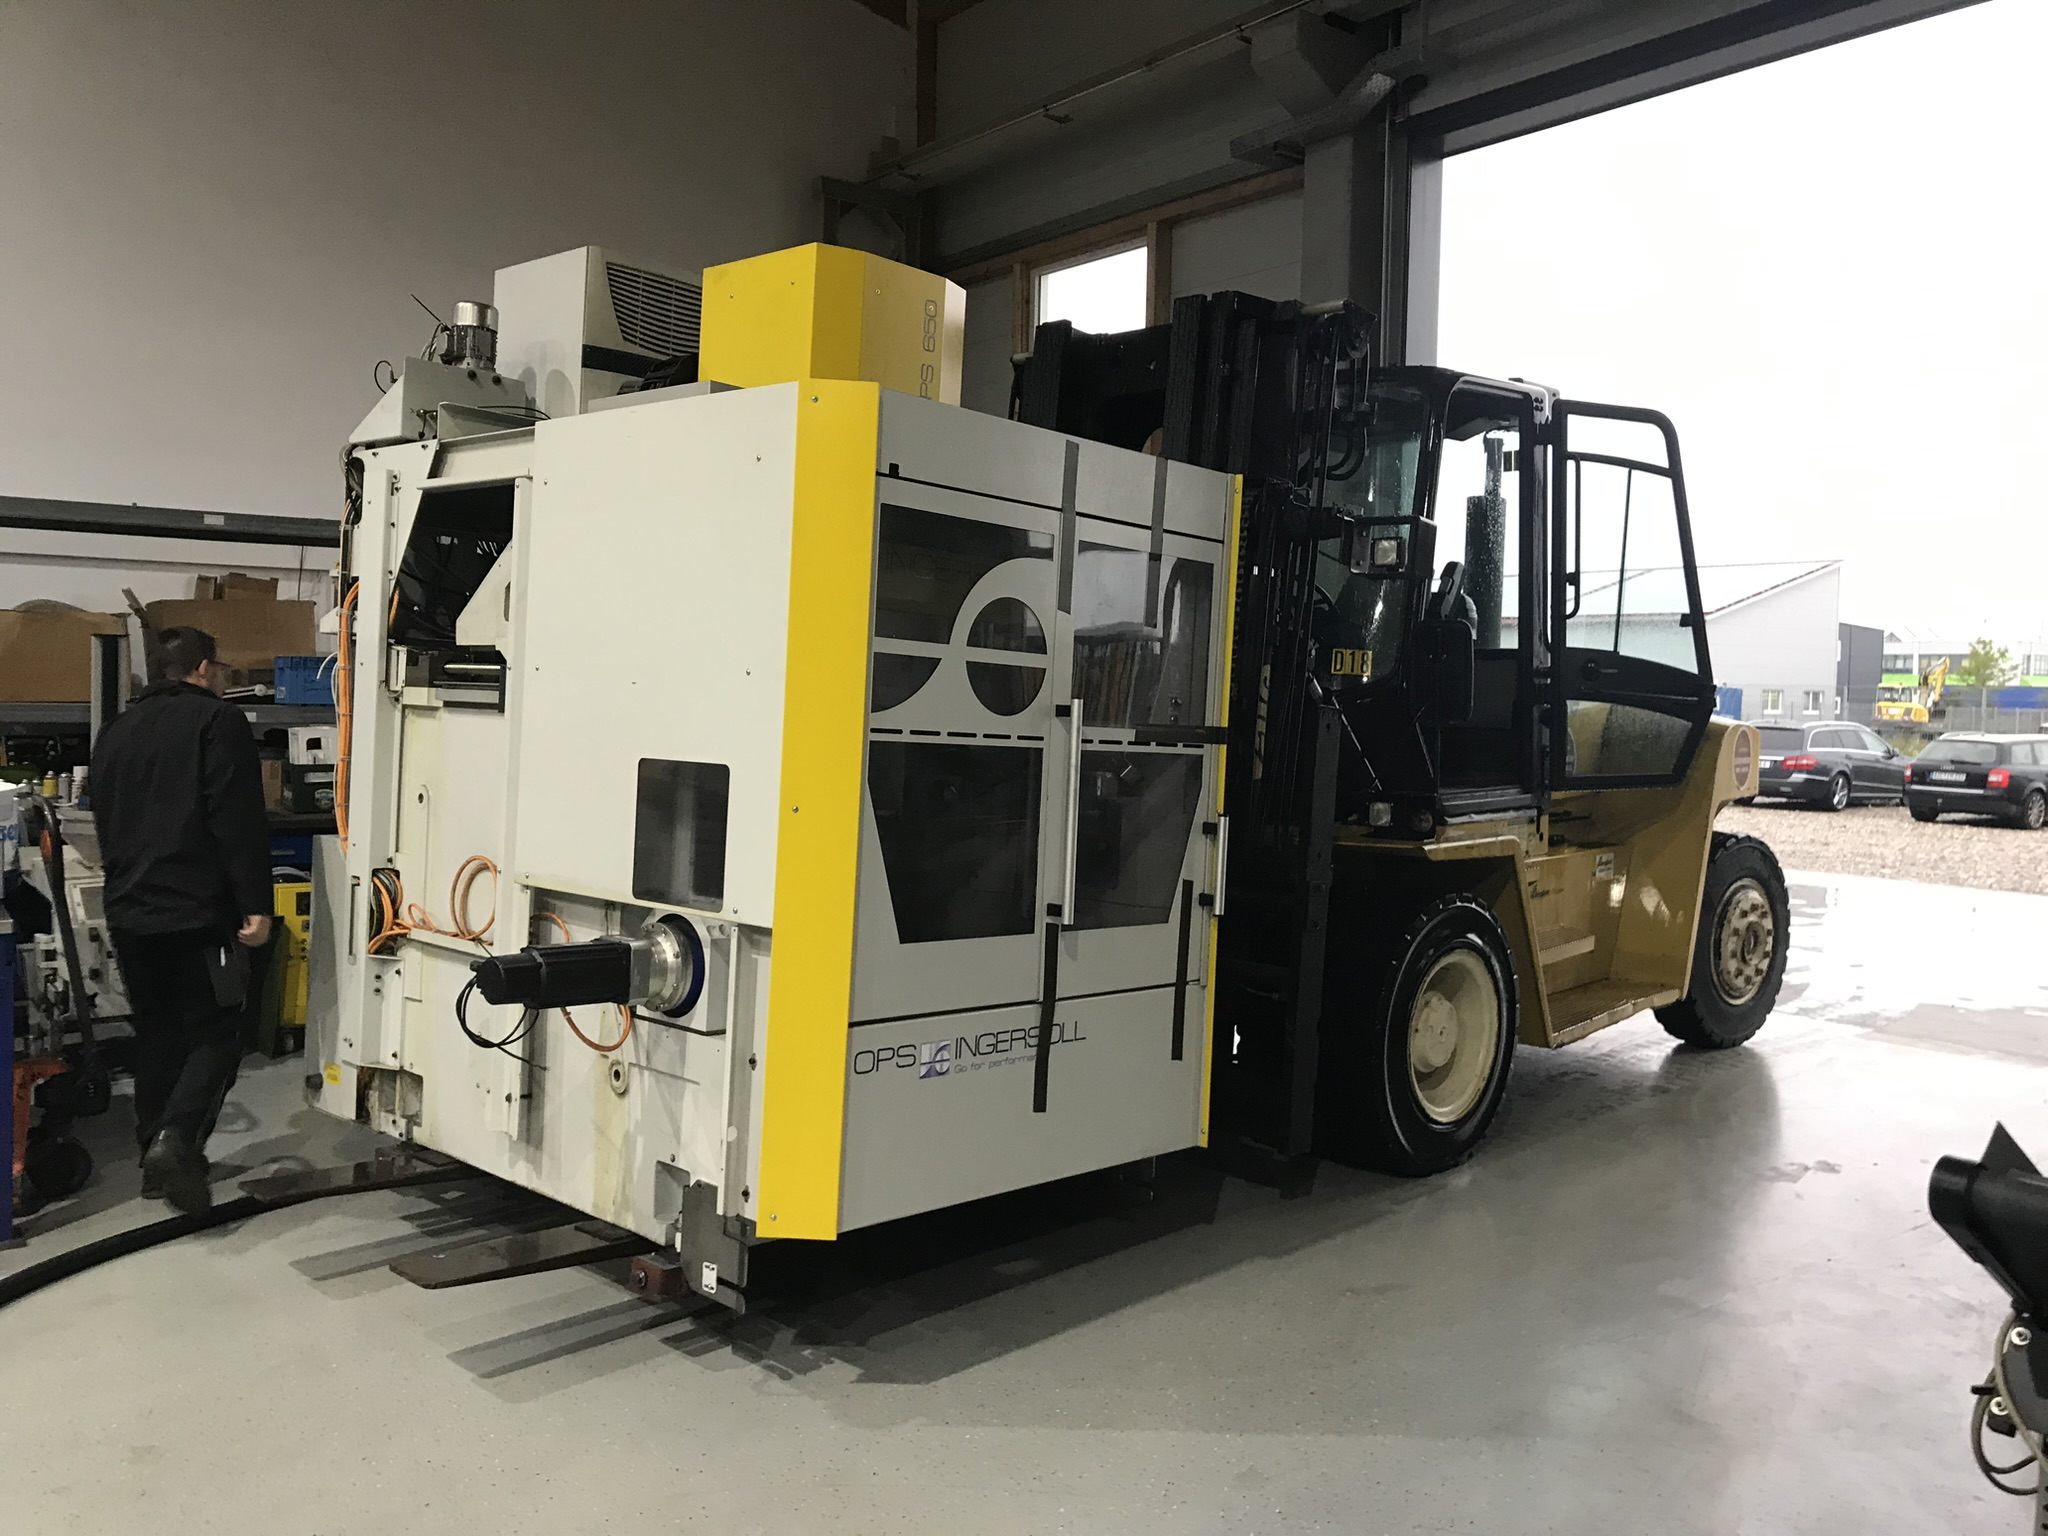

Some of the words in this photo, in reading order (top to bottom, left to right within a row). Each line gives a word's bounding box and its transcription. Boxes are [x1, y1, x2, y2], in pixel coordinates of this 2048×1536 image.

[922, 299, 937, 352] 650
[1333, 650, 1369, 673] D18
[854, 1044, 917, 1075] OPS
[954, 1063, 968, 1074] Go
[970, 1061, 986, 1071] for
